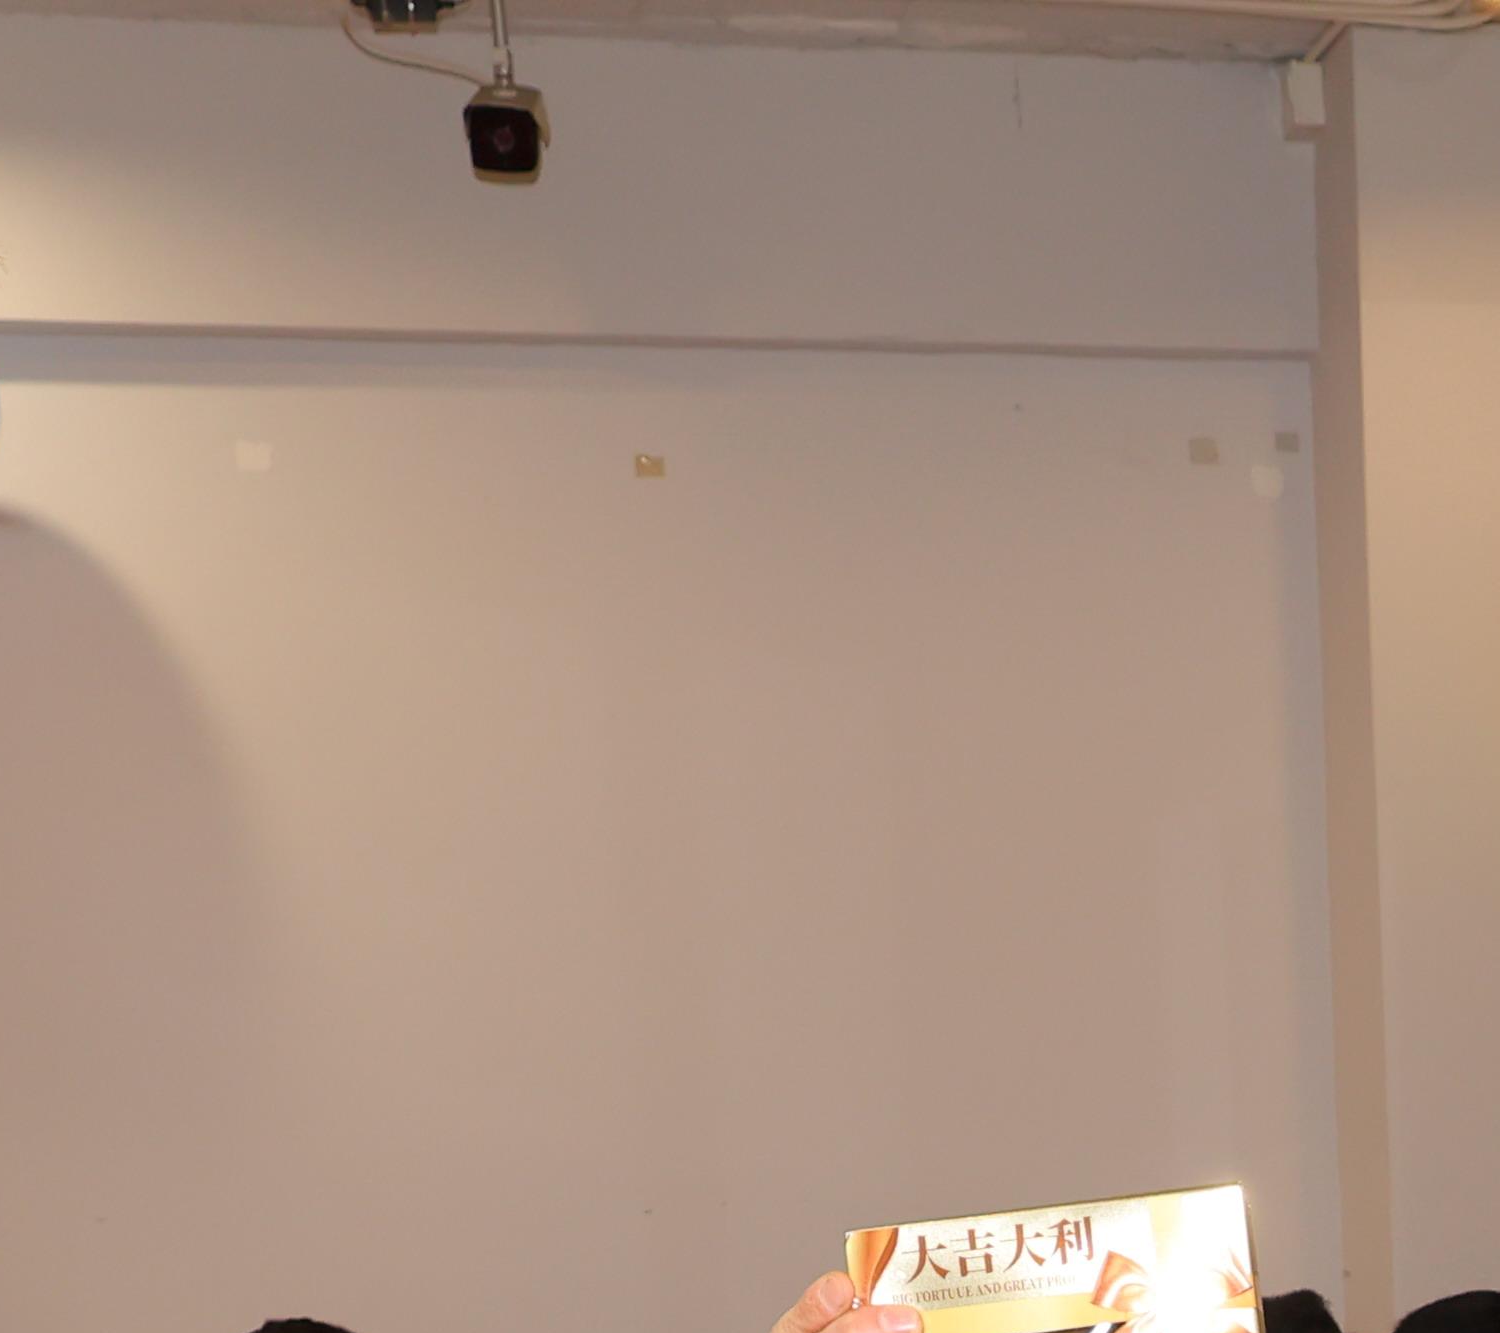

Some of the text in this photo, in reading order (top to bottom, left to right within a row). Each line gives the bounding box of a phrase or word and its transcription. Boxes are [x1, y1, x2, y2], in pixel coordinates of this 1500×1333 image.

[902, 1215, 1095, 1285] 大吉大利
[975, 1281, 1001, 1296] AND
[1004, 1277, 1043, 1293] GREAT
